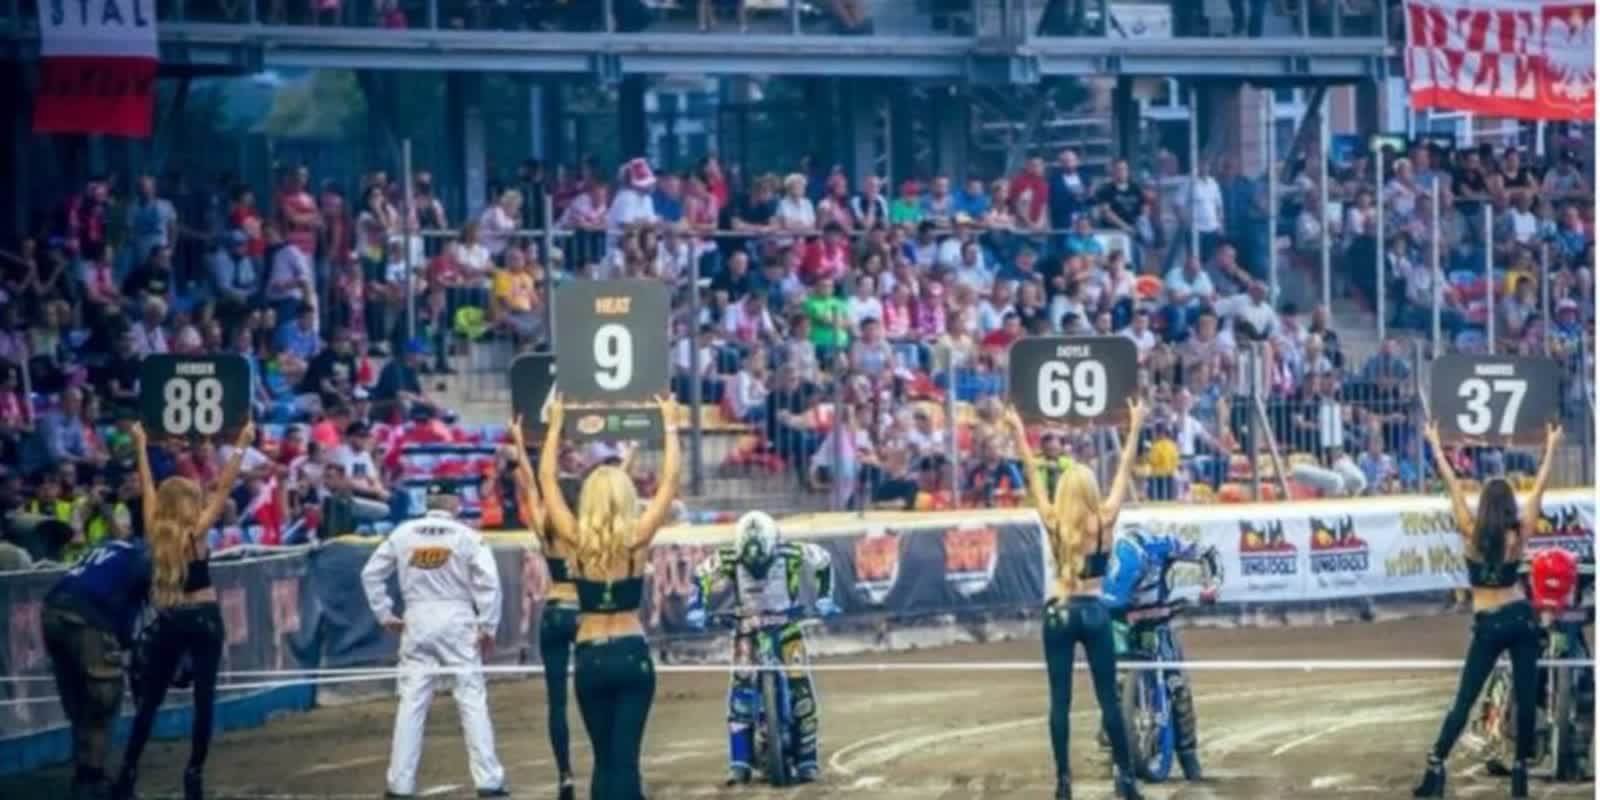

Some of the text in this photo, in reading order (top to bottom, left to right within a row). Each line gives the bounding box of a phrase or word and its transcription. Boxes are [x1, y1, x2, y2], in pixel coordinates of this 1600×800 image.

[595, 296, 632, 315] HEAT
[594, 323, 633, 390] 9
[162, 377, 225, 434] 88
[1037, 359, 1108, 417] 69
[1456, 378, 1528, 435] 37
